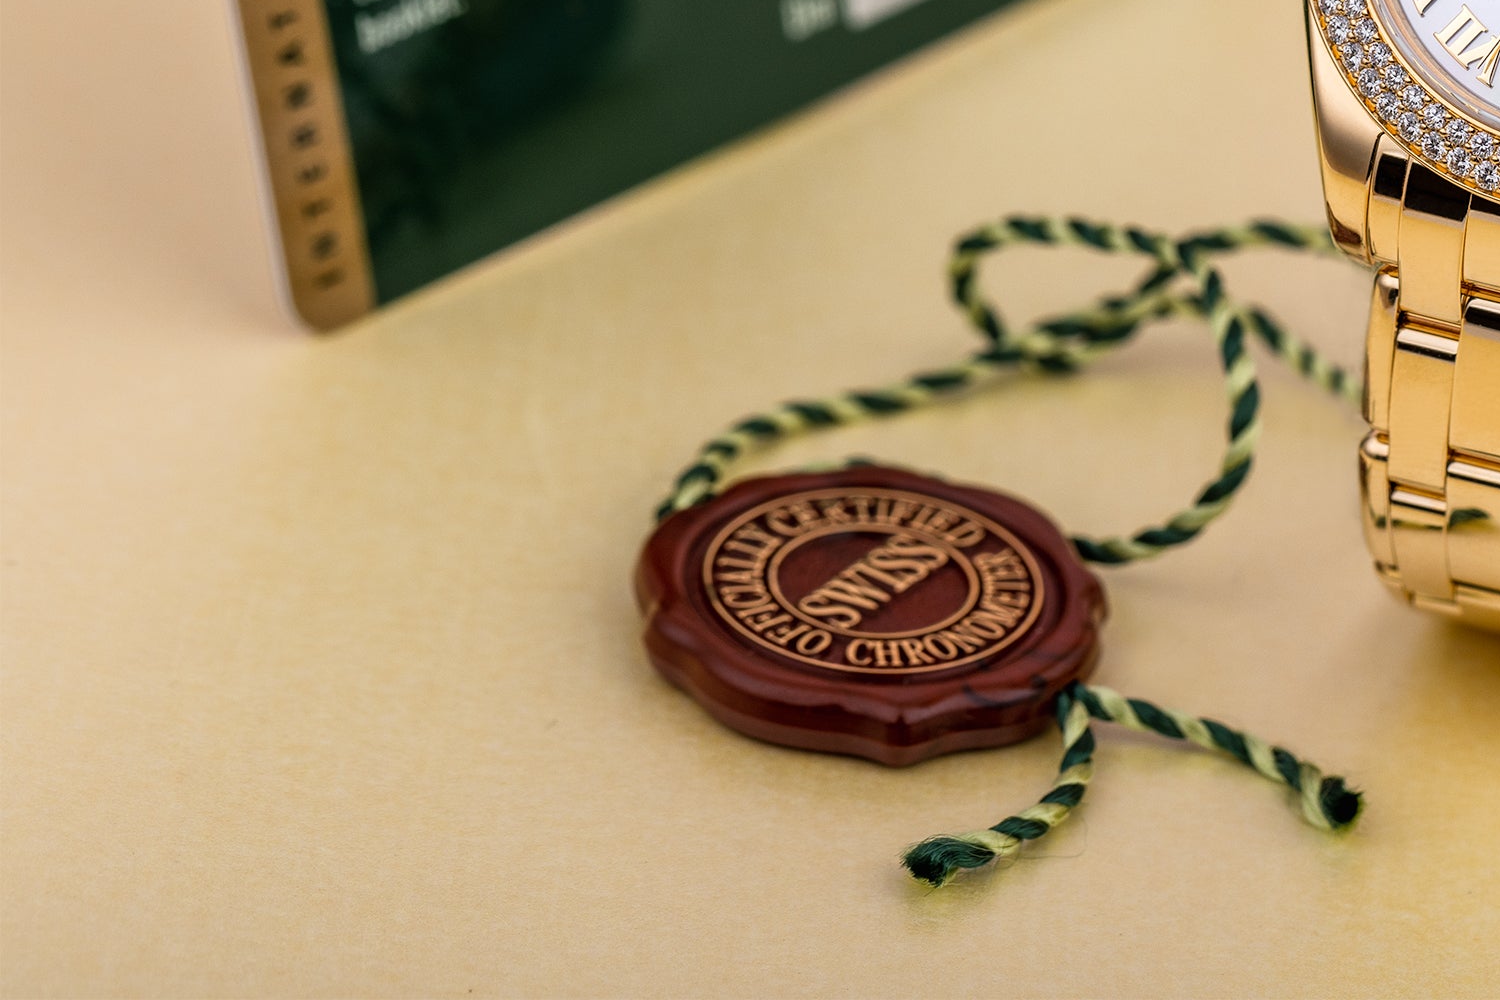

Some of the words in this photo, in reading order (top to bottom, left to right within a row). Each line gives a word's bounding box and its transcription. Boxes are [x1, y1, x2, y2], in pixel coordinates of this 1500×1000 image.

[766, 494, 987, 549] CERTIFIED
[715, 520, 833, 657] OFFICIALLY
[801, 532, 951, 630] SWISS
[845, 546, 1032, 667] CHRONOMETER
